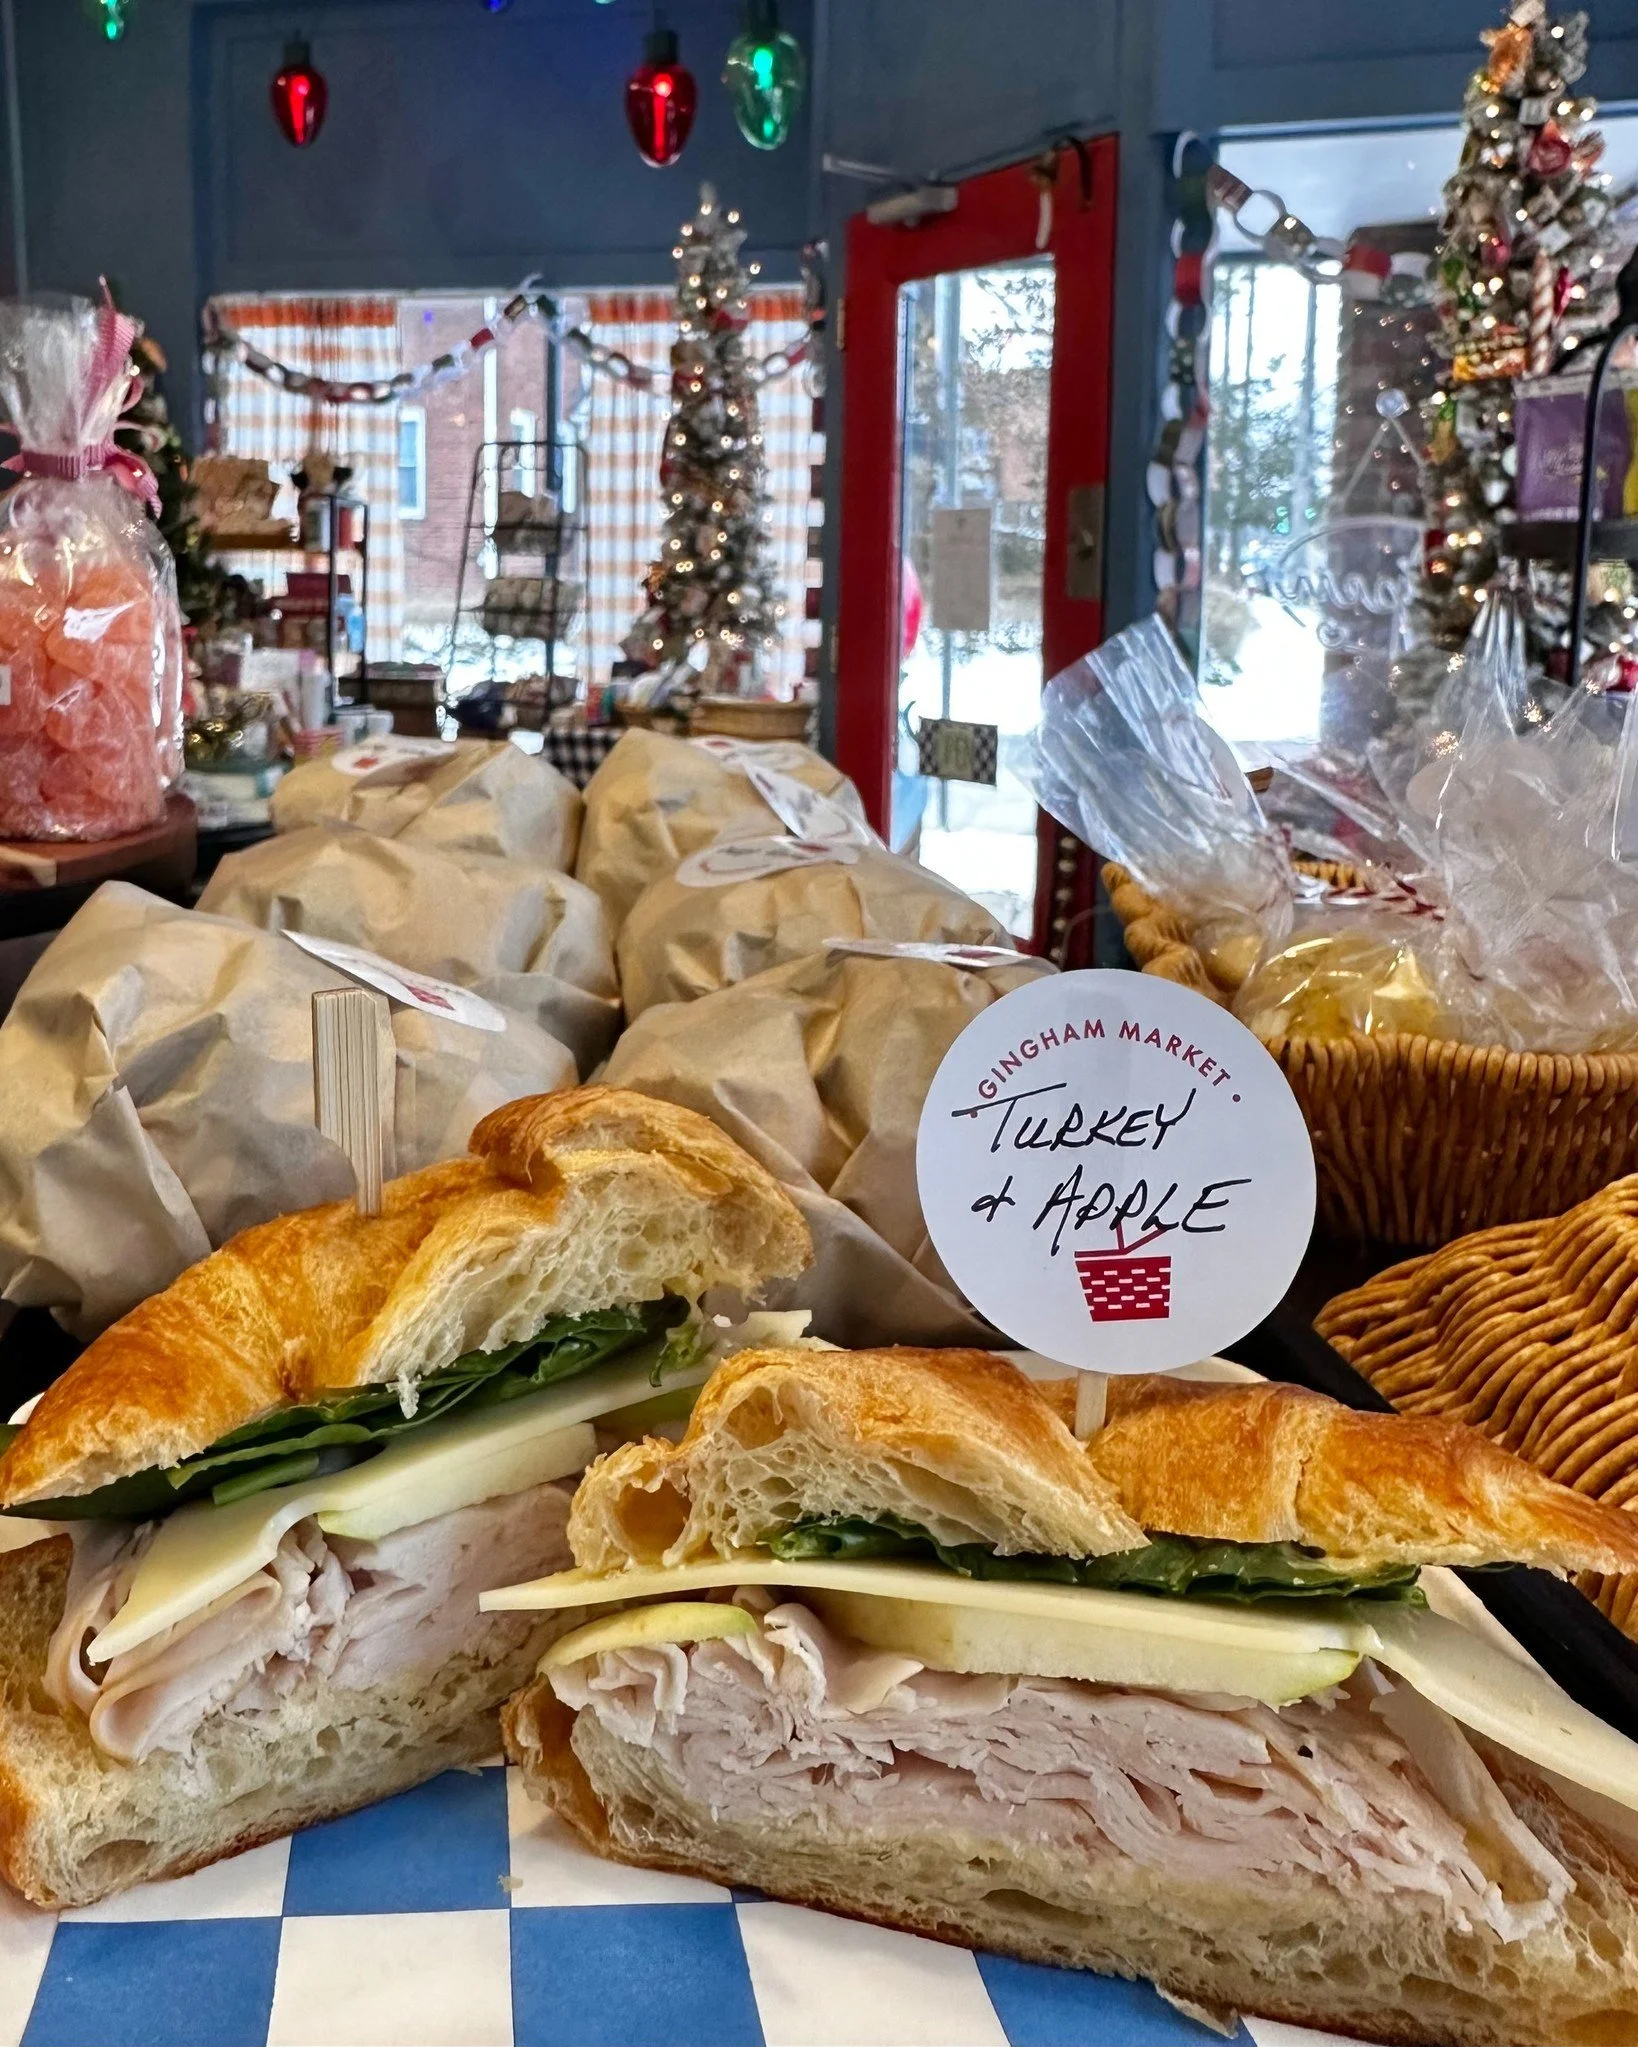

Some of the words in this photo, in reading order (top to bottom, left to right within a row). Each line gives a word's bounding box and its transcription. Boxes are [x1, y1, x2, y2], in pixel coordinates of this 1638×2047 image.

[978, 1018, 1105, 1099] GINGHAM
[1118, 1020, 1232, 1088] MARKET
[951, 1082, 1198, 1153] TURKEY
[1032, 1164, 1253, 1257] APPLE
